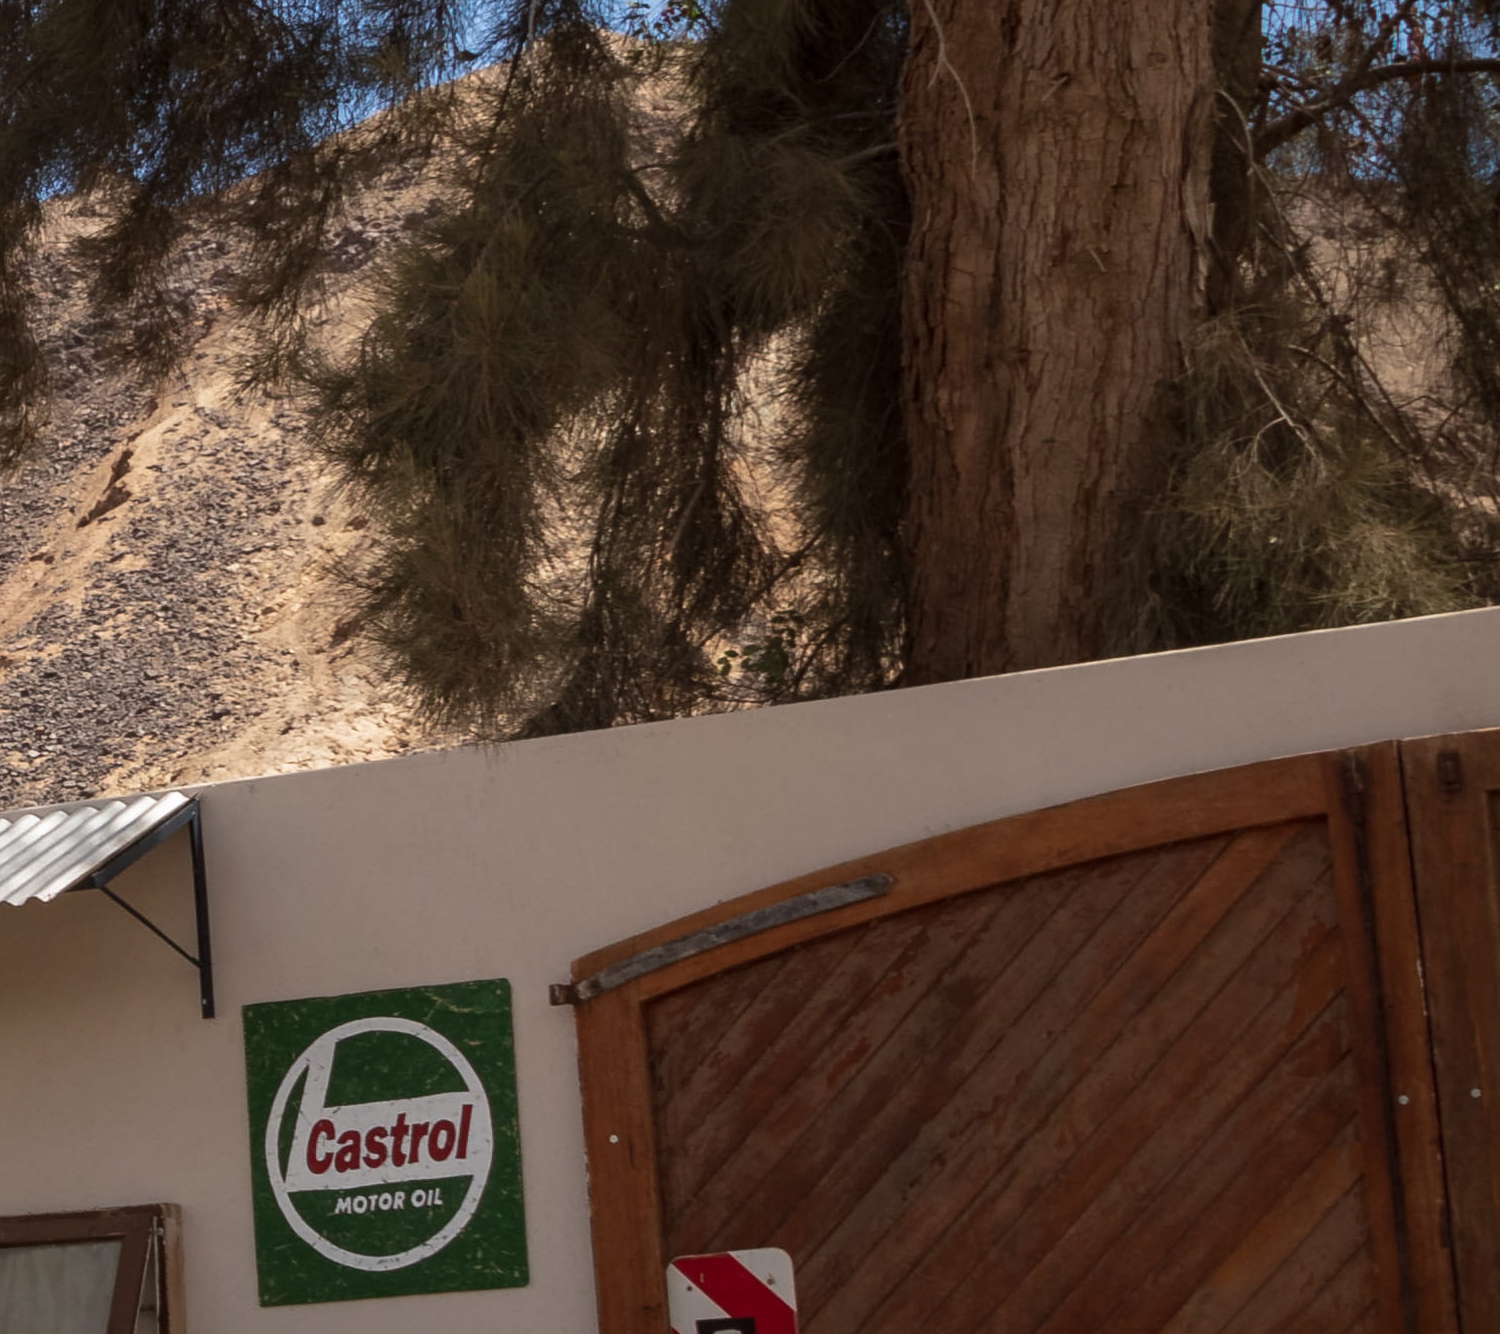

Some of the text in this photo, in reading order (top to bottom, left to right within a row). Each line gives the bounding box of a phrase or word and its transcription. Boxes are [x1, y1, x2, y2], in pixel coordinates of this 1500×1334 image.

[307, 1104, 473, 1175] Castrol
[334, 1188, 443, 1215] MOTOR OIL
